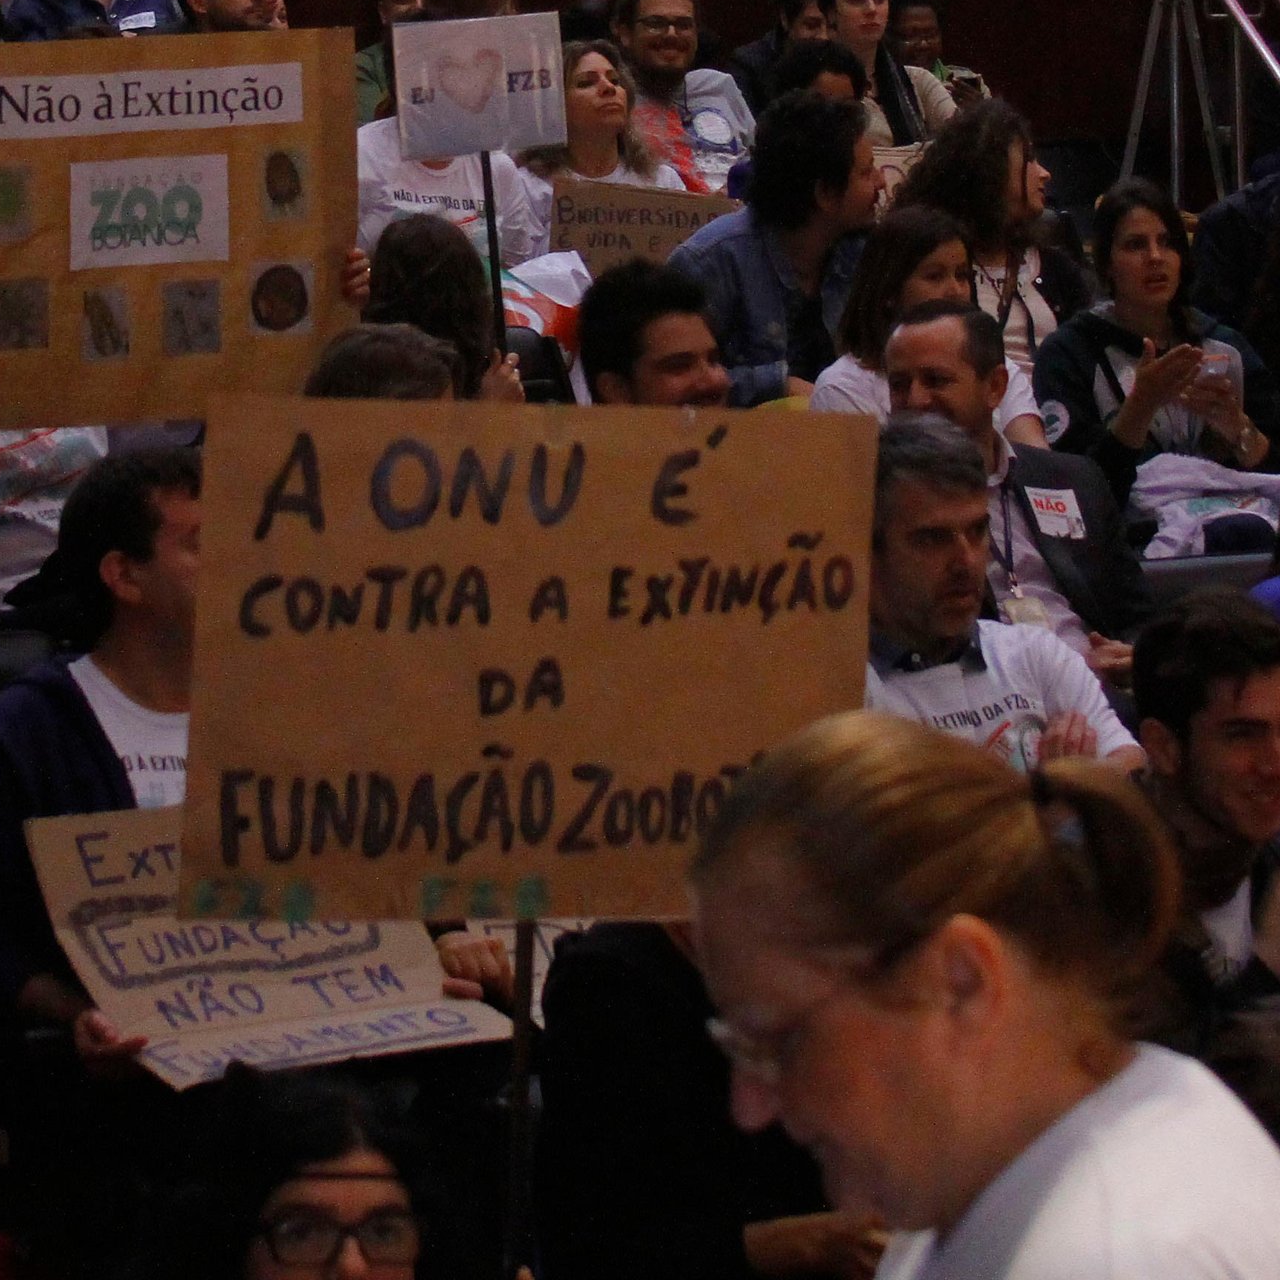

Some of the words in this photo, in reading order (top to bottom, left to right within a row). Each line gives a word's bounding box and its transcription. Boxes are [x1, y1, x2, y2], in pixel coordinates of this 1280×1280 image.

[92, 81, 114, 120] à
[121, 76, 284, 122] Extinção
[507, 69, 552, 94] FZB
[90, 185, 203, 232] ZOO
[253, 431, 326, 541] A
[369, 437, 586, 532] ONU
[651, 425, 728, 525] É
[1033, 498, 1067, 513] NÃO
[238, 564, 492, 637] CONTRA
[529, 574, 569, 623] A
[606, 531, 855, 624] EXTINÇÃO
[477, 656, 566, 718] DA
[981, 702, 1004, 721] DA
[220, 743, 557, 867] FUNDAÇÃO
[97, 919, 352, 978] FUNDAÇÃO
[154, 976, 266, 1031] NÃO
[292, 962, 407, 1009] TEM
